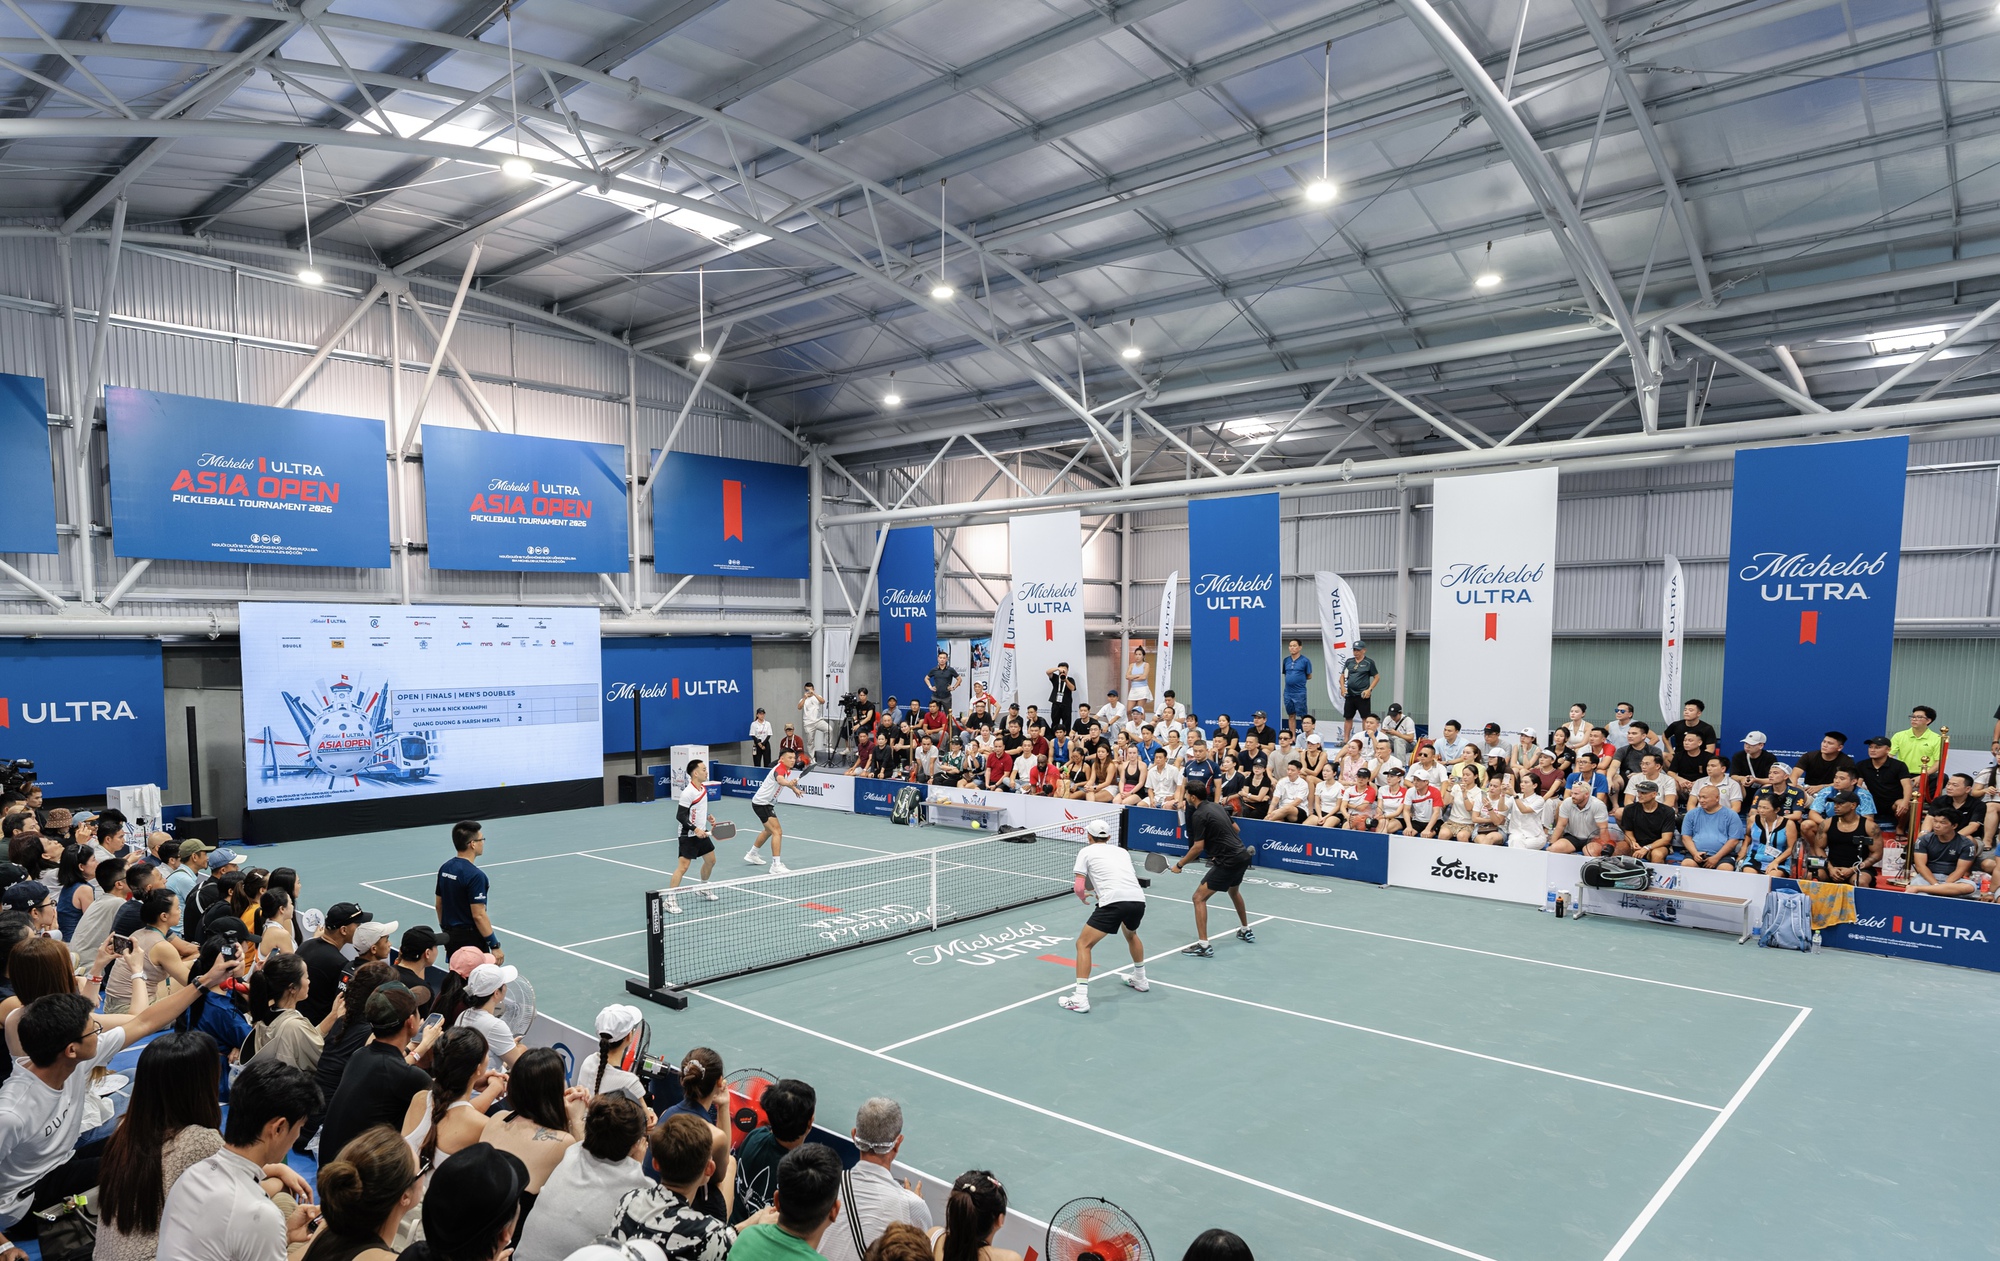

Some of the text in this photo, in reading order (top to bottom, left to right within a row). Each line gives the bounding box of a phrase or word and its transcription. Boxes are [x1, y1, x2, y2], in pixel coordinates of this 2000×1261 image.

[197, 452, 324, 476] Michelob ULTRA
[170, 469, 340, 504] ASIA OPEN
[488, 478, 580, 496] Michelob ULTRA
[172, 494, 333, 514] PICKLEBALL TOURNAMENT 2026
[469, 493, 592, 519] ASIA OPEN
[470, 514, 516, 524] PICKLEBALL
[518, 516, 568, 527] TOURNAMENT
[1440, 563, 1545, 588] Michelob
[1740, 552, 1888, 582] Michelob
[1017, 582, 1078, 602] Michelob
[1194, 573, 1273, 596] Michelob
[1760, 582, 1868, 602] ULTRA
[882, 588, 932, 606] Michelob
[1207, 596, 1265, 610] ULTRA
[1456, 589, 1532, 604] ULTRA
[890, 606, 928, 618] ULTRA
[1027, 602, 1072, 614] ULTRA
[1330, 588, 1344, 638] ULTRA
[1000, 651, 1014, 692] Michelob
[606, 680, 739, 702] Mihelob ULTRA
[22, 700, 136, 724] ULTRA
[318, 739, 371, 749] ASIA OPEN
[863, 791, 887, 802] Michelob
[1061, 826, 1085, 835] KAMITO
[1138, 824, 1174, 837] Michelob
[1262, 839, 1358, 861] Michelob ULTRA
[1431, 862, 1498, 884] zocker
[1910, 921, 1987, 943] ULTRA
[906, 921, 1046, 966] Michelob
[956, 934, 1074, 966] ULTRA
